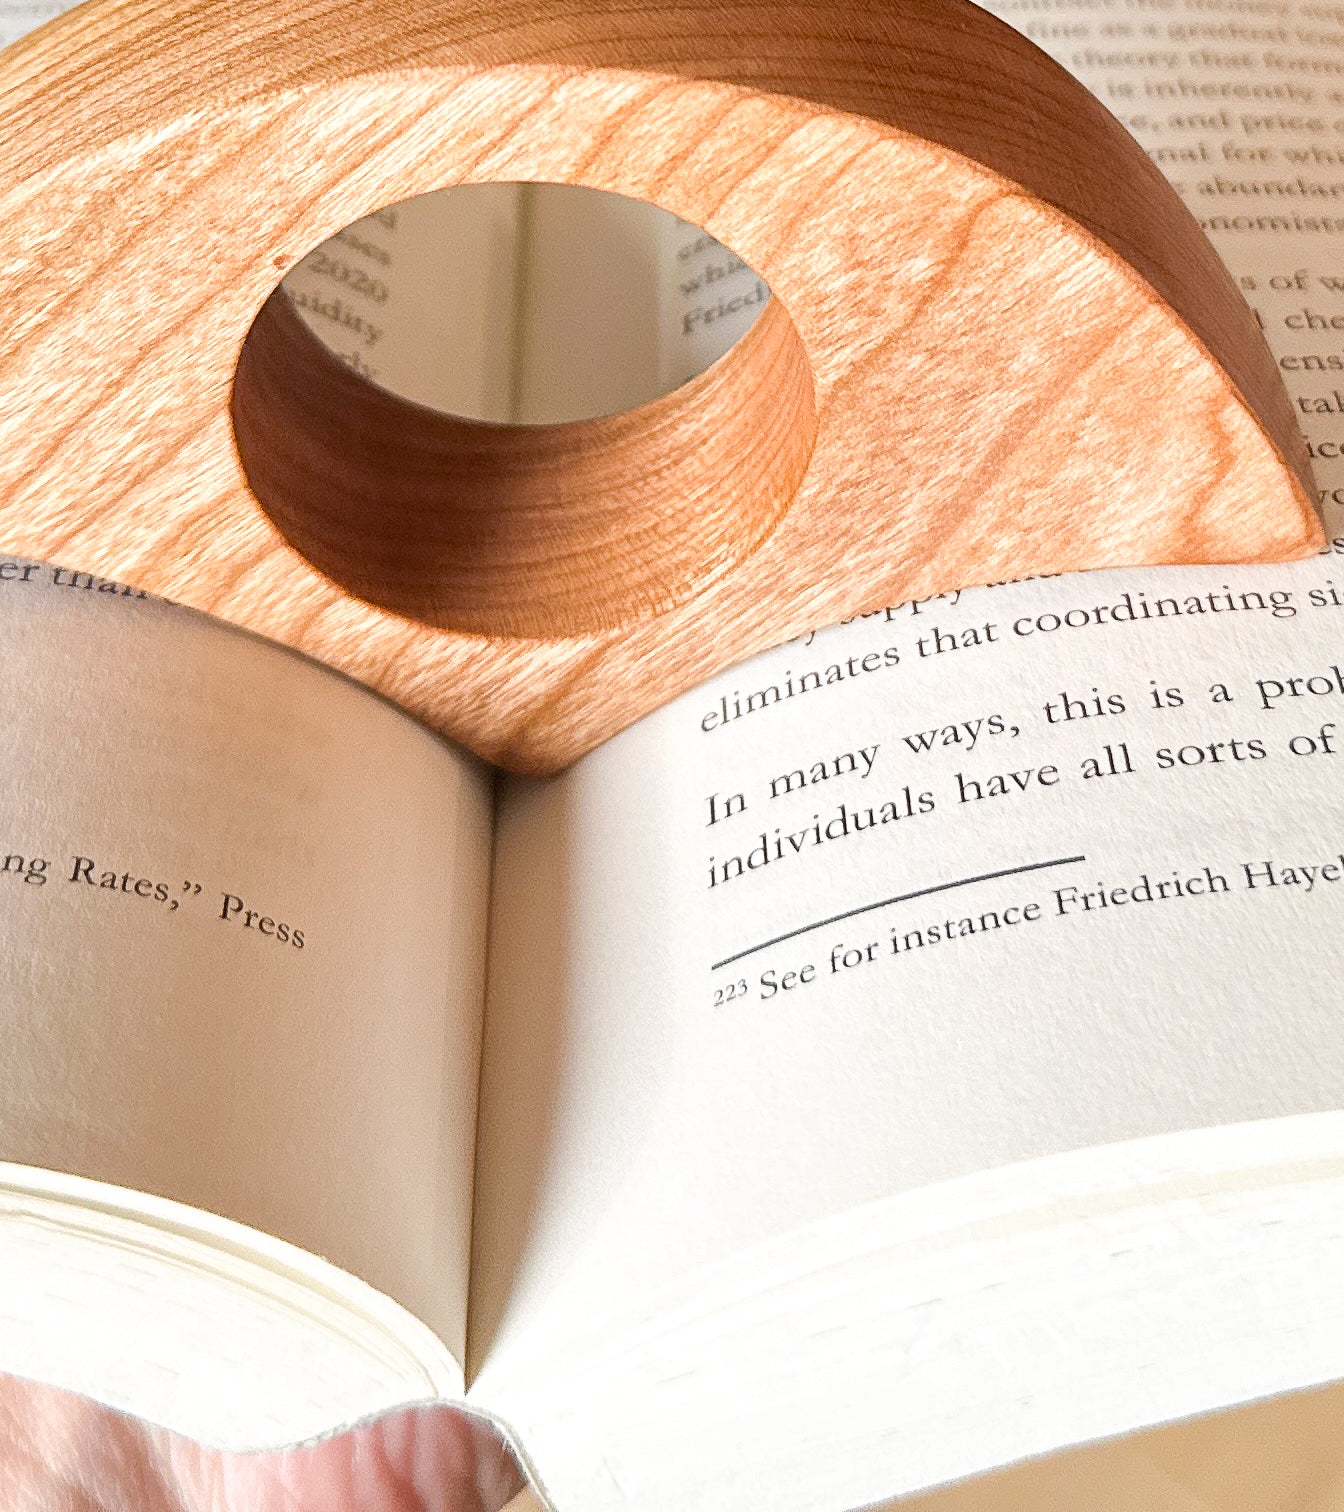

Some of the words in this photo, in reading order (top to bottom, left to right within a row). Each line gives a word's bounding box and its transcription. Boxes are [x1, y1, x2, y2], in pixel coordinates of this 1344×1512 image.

[679, 293, 764, 336] Fried
[1269, 269, 1308, 291] of
[701, 647, 900, 733] eliminates
[916, 623, 998, 658] that
[1013, 586, 1297, 637] coordinating
[707, 794, 747, 826] In
[770, 744, 880, 799] many
[902, 715, 1020, 753] ways,
[1043, 692, 1126, 724] this
[1150, 680, 1184, 709] is
[1209, 684, 1233, 703] a
[709, 786, 935, 888] individuals
[955, 765, 1060, 803] have
[1081, 743, 1135, 779] all
[1156, 739, 1267, 769] sorts
[1289, 723, 1336, 756] of
[68, 856, 202, 911] Rates,”
[219, 892, 304, 949] Press
[714, 979, 748, 1008] 223
[760, 965, 815, 1000] See
[830, 942, 879, 974] for
[891, 903, 1041, 955] instance
[1053, 867, 1230, 916] Friedrich
